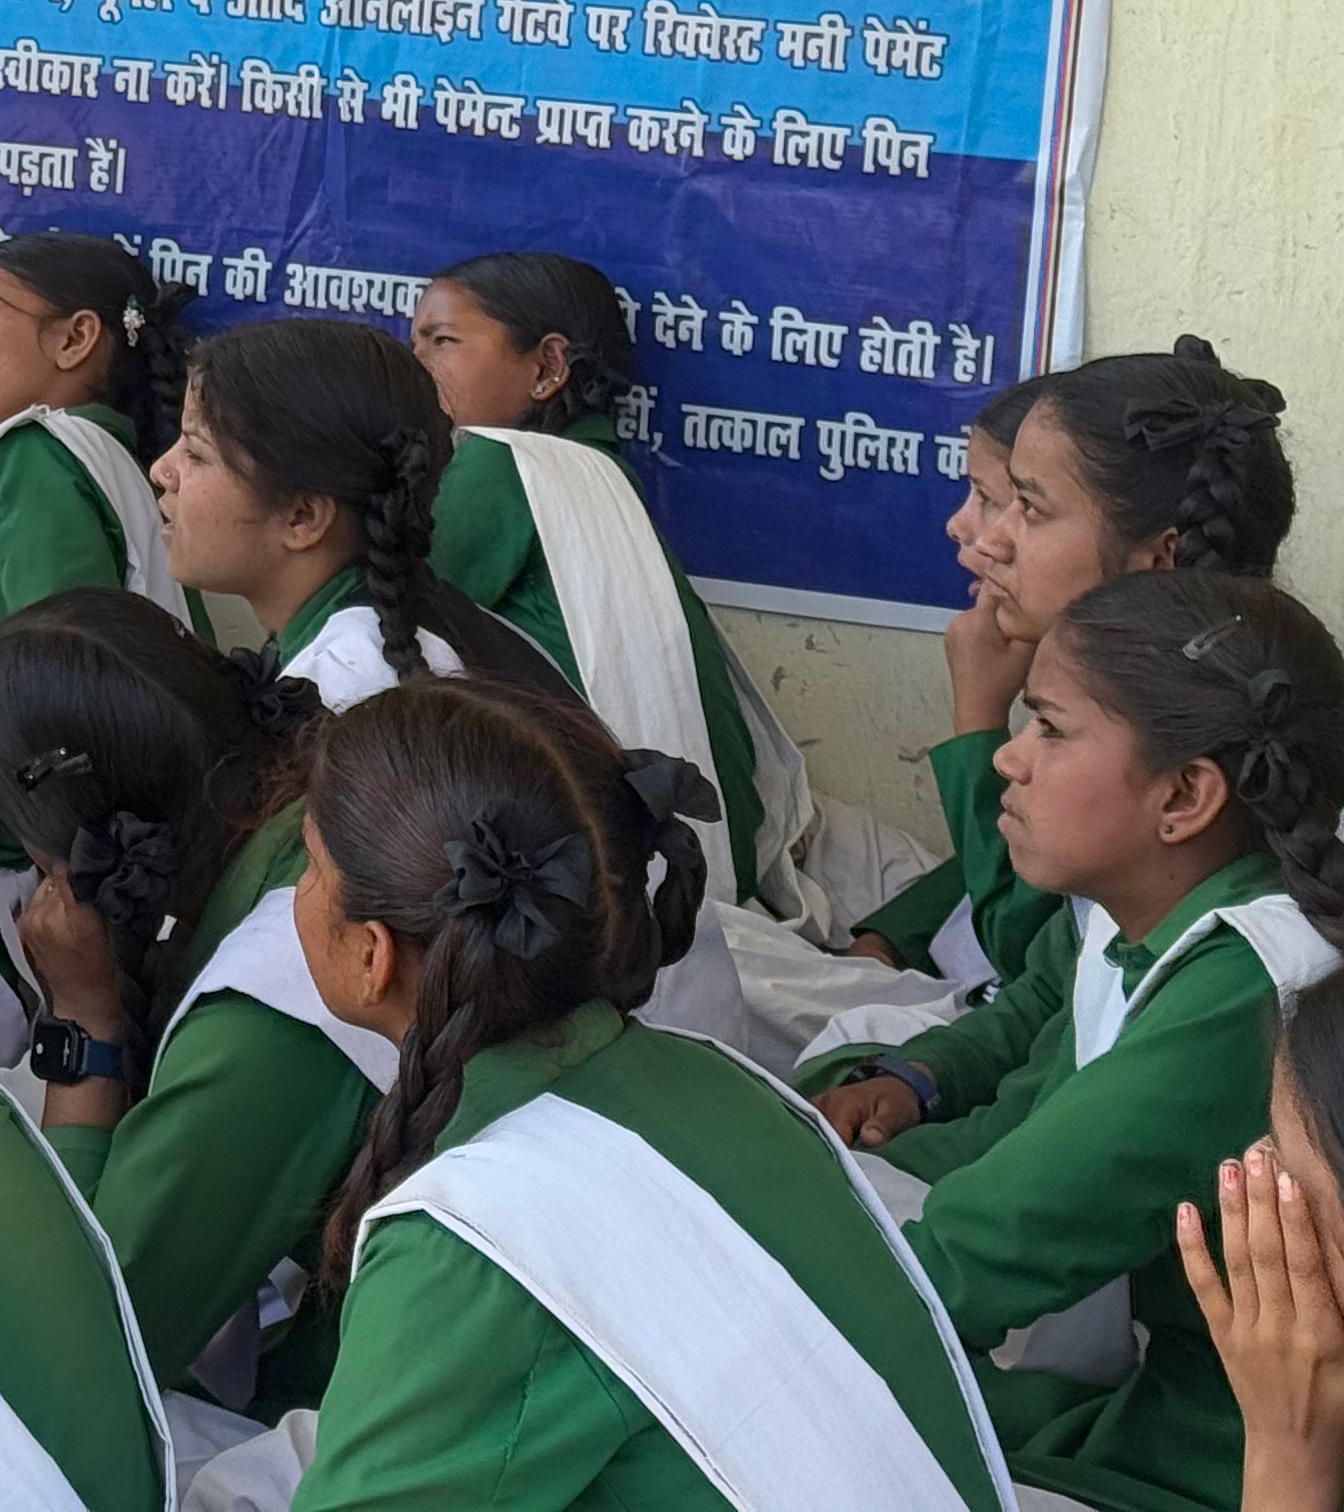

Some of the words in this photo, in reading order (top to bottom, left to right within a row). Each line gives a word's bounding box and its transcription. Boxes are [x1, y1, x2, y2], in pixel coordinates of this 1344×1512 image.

[585, 6, 633, 51] पर
[642, 0, 766, 62] रिक्वेस्ट
[776, 14, 852, 70] मनी
[863, 17, 947, 78] पेमेंट
[113, 59, 154, 103] ना
[239, 59, 327, 119] किसी
[336, 68, 369, 123] से
[381, 74, 423, 129] भी
[433, 77, 525, 139] पेमेन्ट
[535, 99, 616, 149] प्राप्त
[626, 100, 709, 157] करने
[720, 104, 760, 161] के
[772, 109, 852, 170] लिए
[861, 117, 934, 178] पिन
[149, 238, 213, 296] पिन
[222, 247, 273, 302] की
[652, 292, 708, 351] देने
[719, 300, 759, 355] के
[769, 306, 849, 368] लिए
[858, 316, 942, 379] होती
[682, 404, 805, 459] तत्काल
[816, 412, 924, 480] पुलिस
